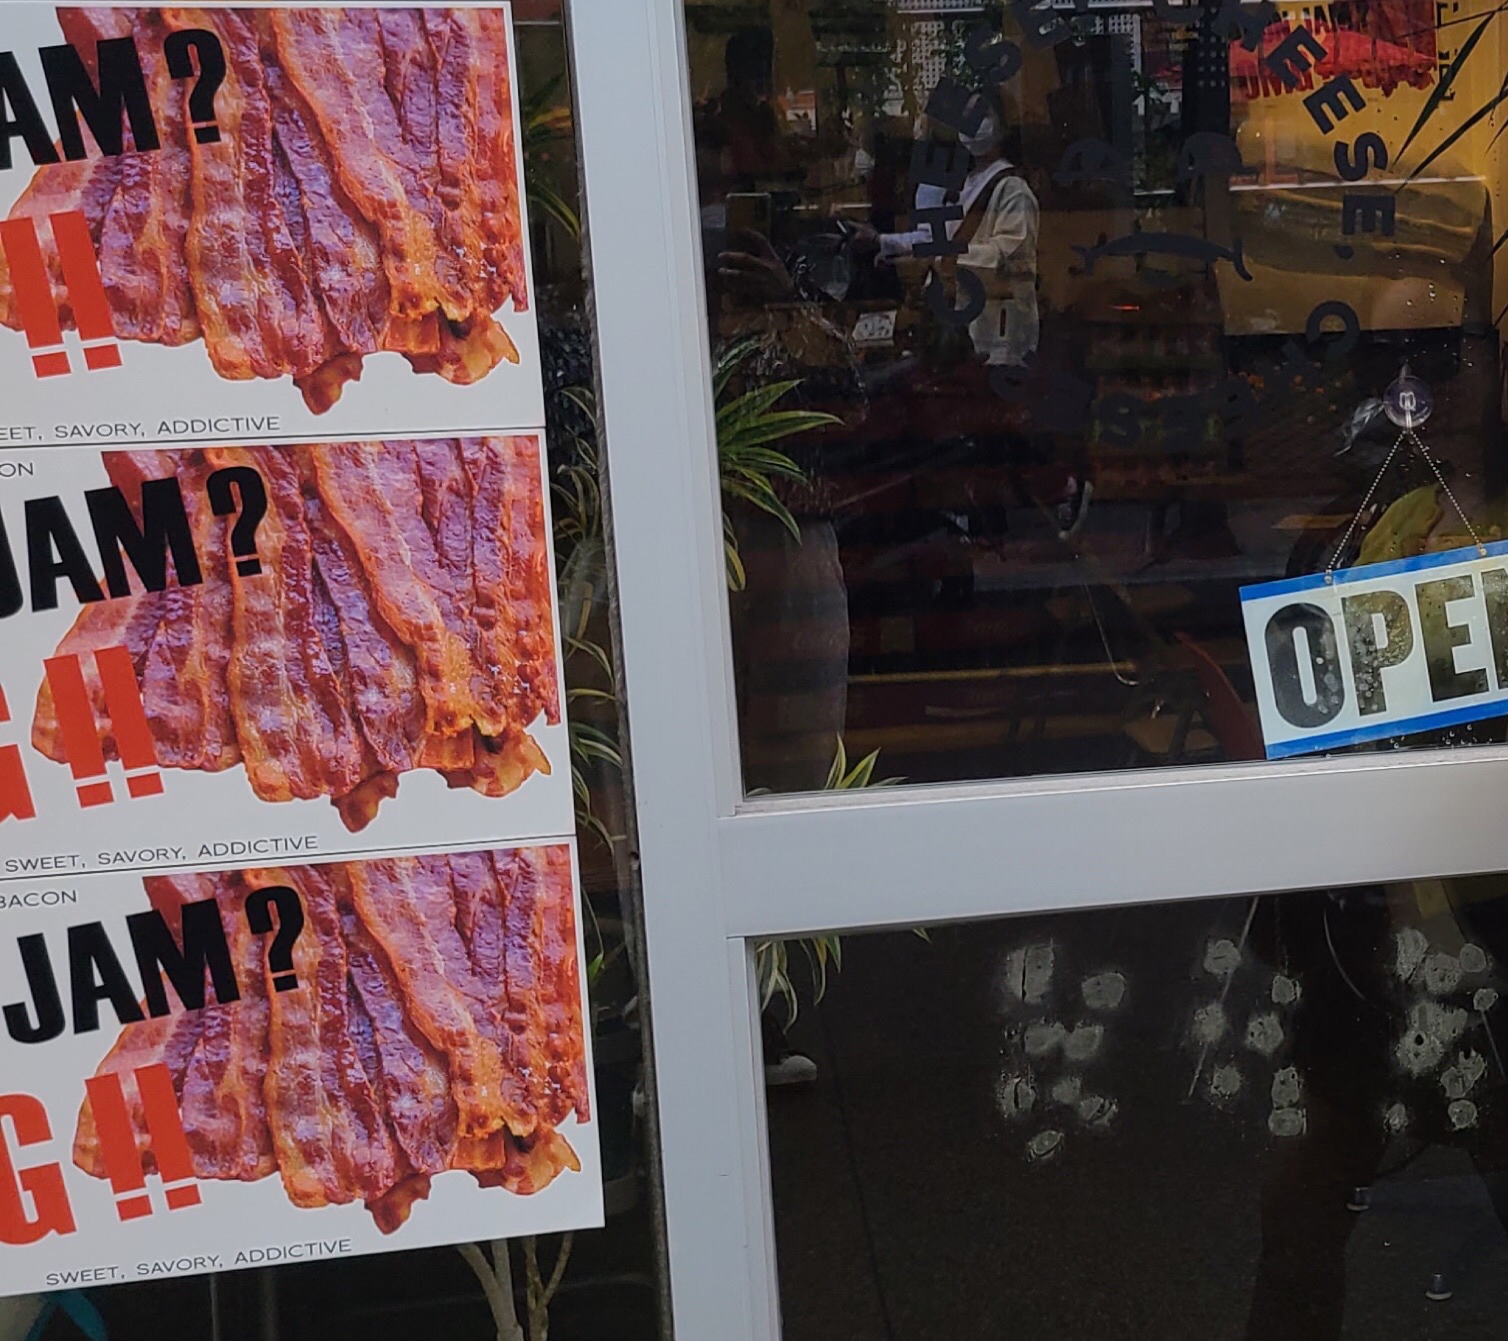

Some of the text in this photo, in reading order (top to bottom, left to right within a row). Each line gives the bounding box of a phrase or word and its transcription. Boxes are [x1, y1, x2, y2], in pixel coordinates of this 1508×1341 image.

[55, 422, 145, 438] SAVORY,
[157, 416, 281, 435] ADDICTIVE
[5, 835, 318, 872] SWEET, SAVORY, ADDICTIVE
[46, 1239, 352, 1286] SWEET, SAVORY, ADDICTIVE
